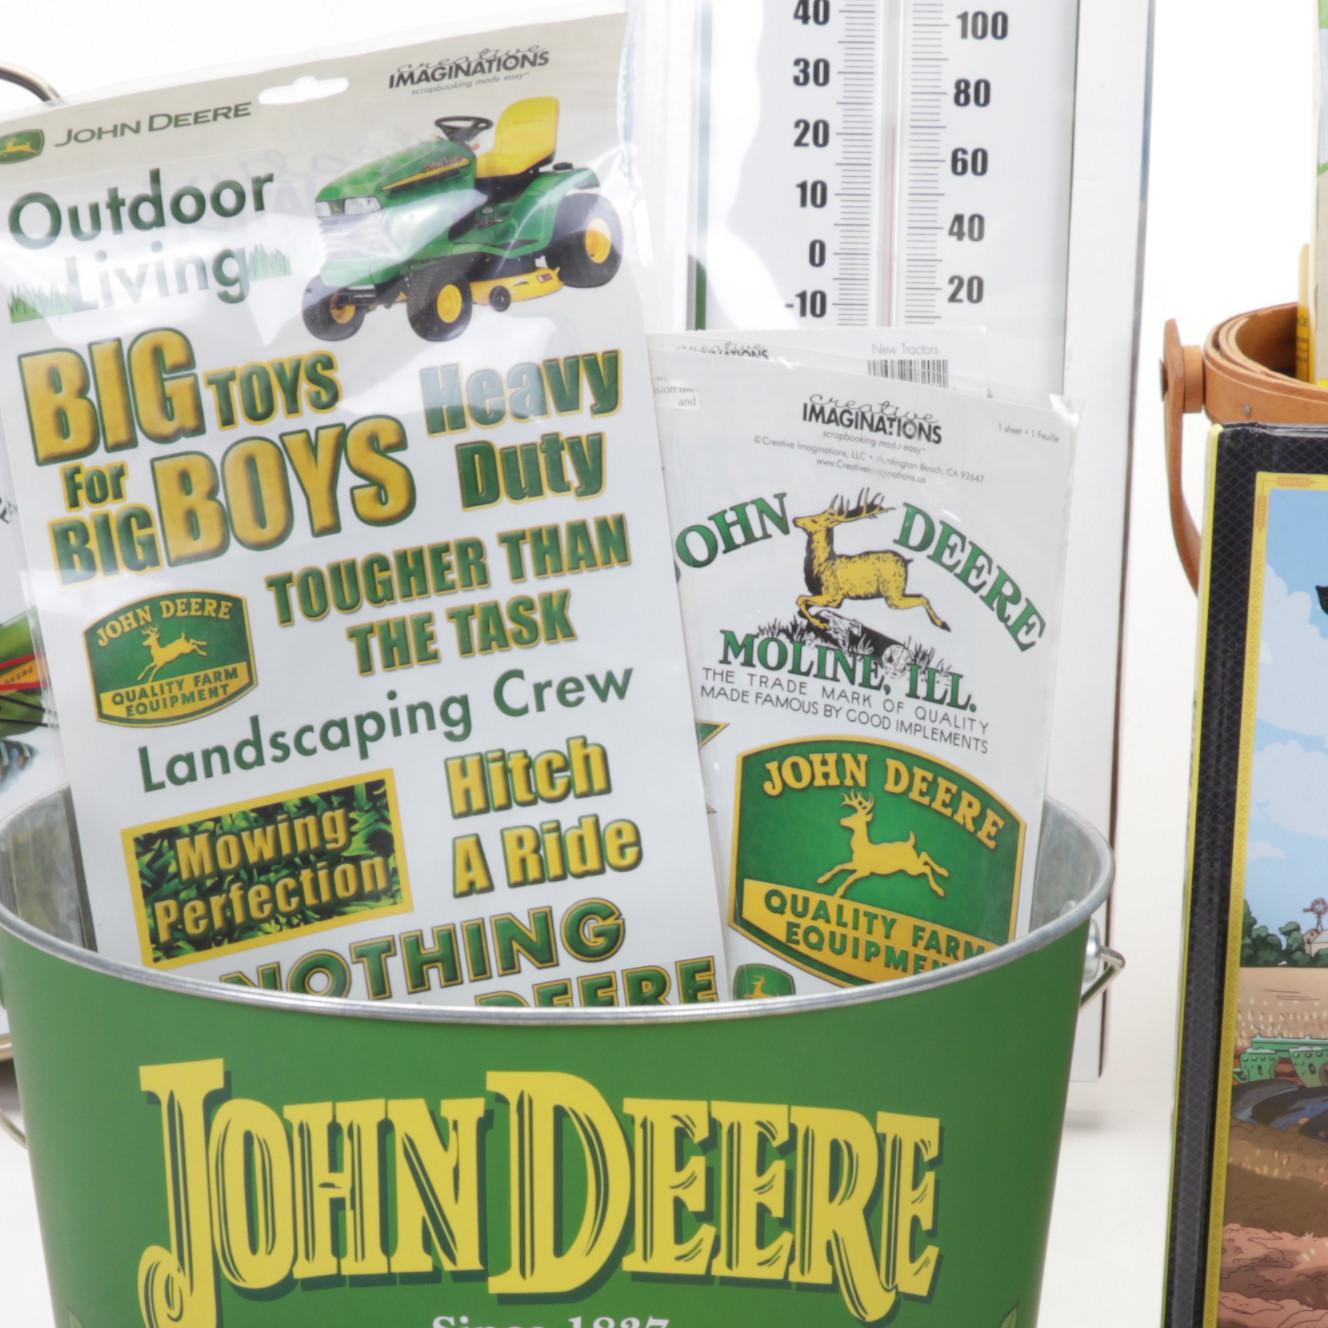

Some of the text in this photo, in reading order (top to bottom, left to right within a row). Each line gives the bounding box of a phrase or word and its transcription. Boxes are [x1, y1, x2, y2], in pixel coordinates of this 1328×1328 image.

[793, 0, 831, 25] 40
[956, 11, 1009, 40] 100
[389, 50, 549, 89] IMAGINATIONS
[793, 58, 830, 87] 30
[953, 78, 991, 108] 80
[54, 102, 252, 147] JOHN DEERE
[793, 119, 830, 148] 20
[950, 147, 989, 176] 60
[8, 168, 274, 249] Outdoor
[796, 180, 828, 209] 10
[808, 239, 826, 268] 0
[947, 213, 985, 242] 40
[65, 240, 250, 304] Living
[947, 275, 984, 304] 20
[785, 290, 828, 318] -10
[872, 342, 939, 355] New Tractors
[17, 327, 343, 467] BIG TOYS
[419, 349, 623, 437] Heavy
[802, 403, 942, 444] IMAGINATIONS
[48, 414, 417, 587] BIG BOYS
[60, 459, 128, 511] For
[454, 430, 607, 512] Duty
[266, 512, 633, 627] TOUGHER THAN
[673, 492, 1046, 652] OHN DEERE
[97, 598, 232, 646] JOHN DEERE
[346, 589, 575, 677] THE TASK
[111, 666, 238, 706] QUALITY FARM
[125, 684, 229, 717] EQUIPMENT
[703, 667, 990, 734] THE TRADE MARK OF QUALITY
[718, 630, 977, 712] MOLINE, ILL.
[138, 668, 635, 793] Landscaping Crew
[700, 685, 751, 703] MADE
[754, 692, 819, 715] FAMOUS
[823, 705, 843, 719] BY
[896, 720, 988, 754] IMPLEMENTS
[443, 735, 612, 821] Hitch
[763, 752, 1006, 850] JOHN DEERE
[174, 801, 353, 884] Mowing
[451, 814, 643, 898] A Ride
[152, 854, 391, 946] Perfection
[764, 888, 985, 961] QUALITY FARM
[785, 920, 952, 975] EQUIPME
[485, 1070, 943, 1328] DEERE
